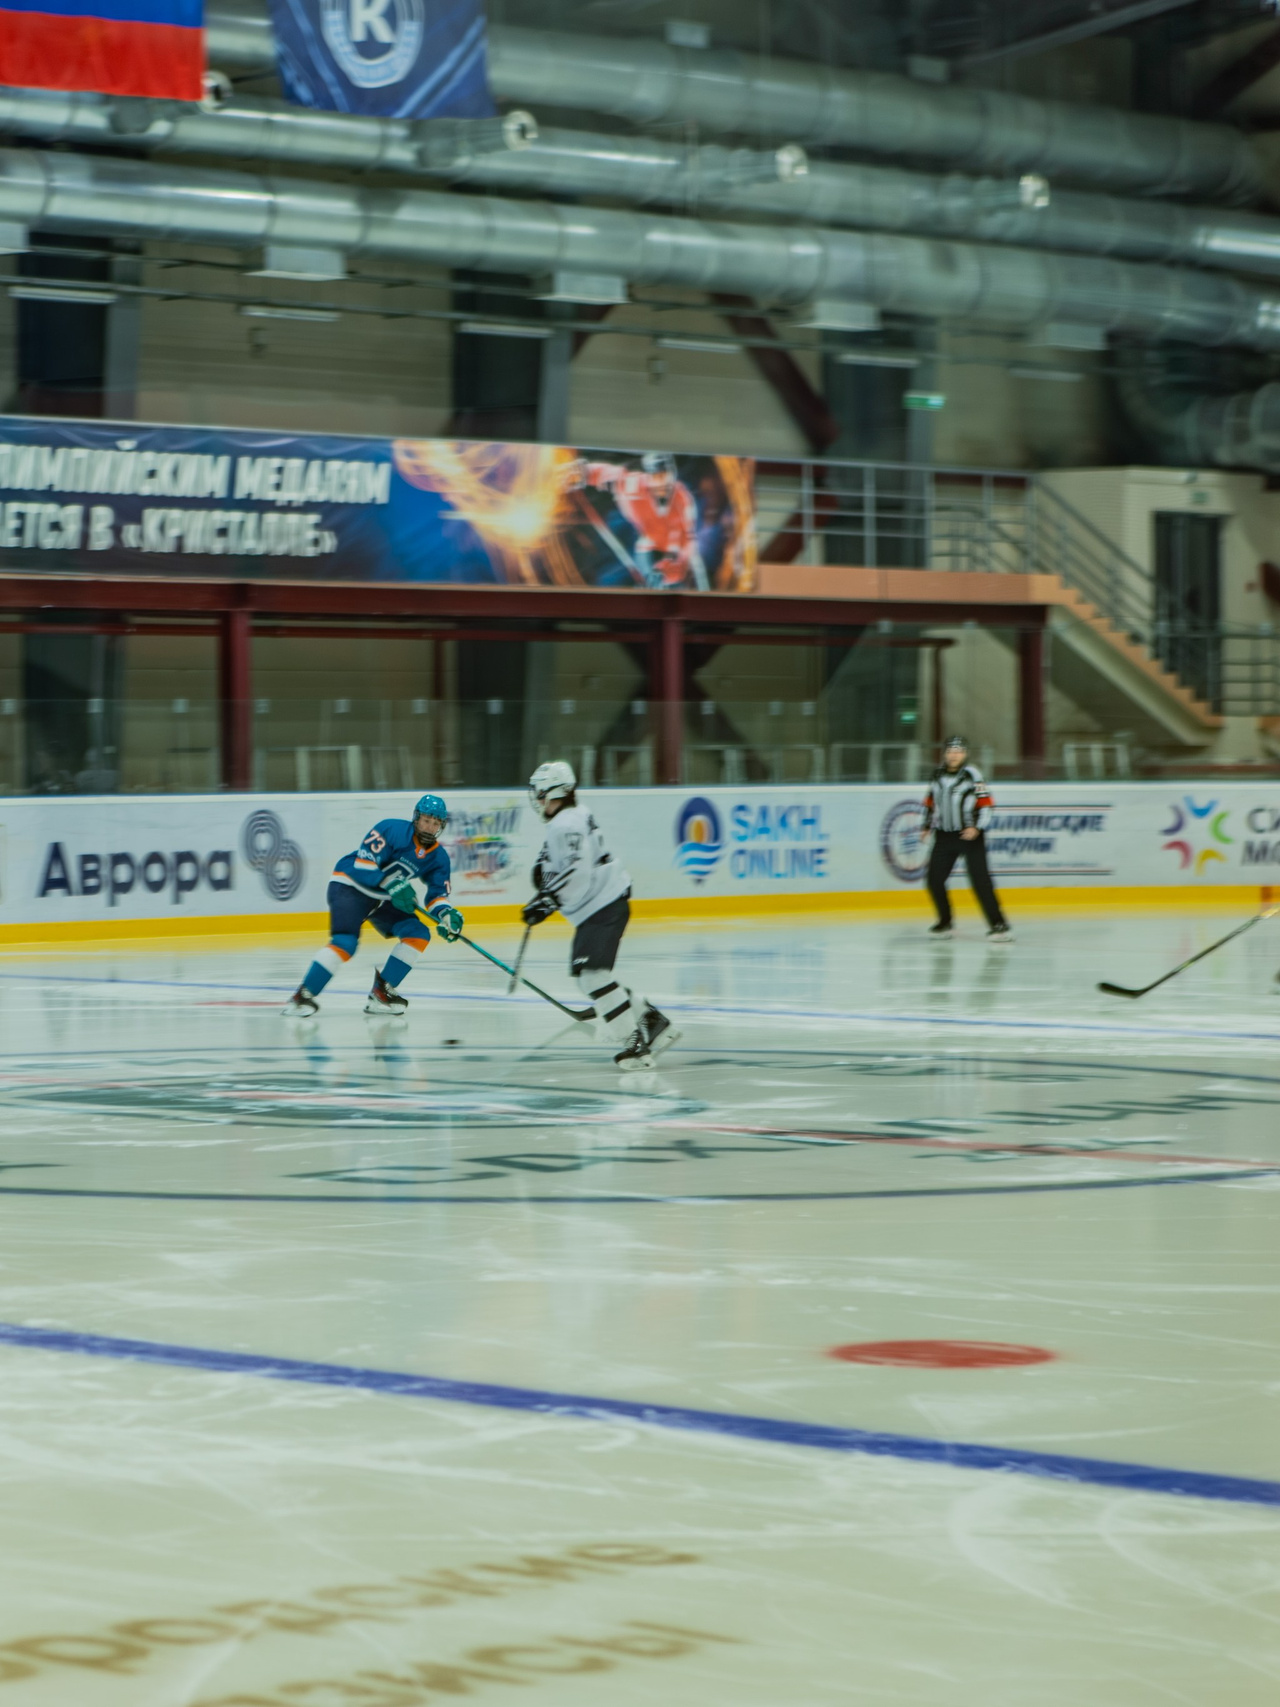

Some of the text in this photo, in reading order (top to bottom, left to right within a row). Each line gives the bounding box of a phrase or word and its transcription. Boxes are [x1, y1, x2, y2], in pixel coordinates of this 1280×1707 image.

[233, 456, 392, 506] МЕДАЛЯМ
[86, 505, 115, 551] В
[121, 508, 338, 557] «КРИСТАЛЛЕ»
[364, 829, 386, 854] 73
[730, 804, 830, 842] SAKH.
[34, 841, 234, 907] Аврора
[730, 848, 830, 879] ONLINE
